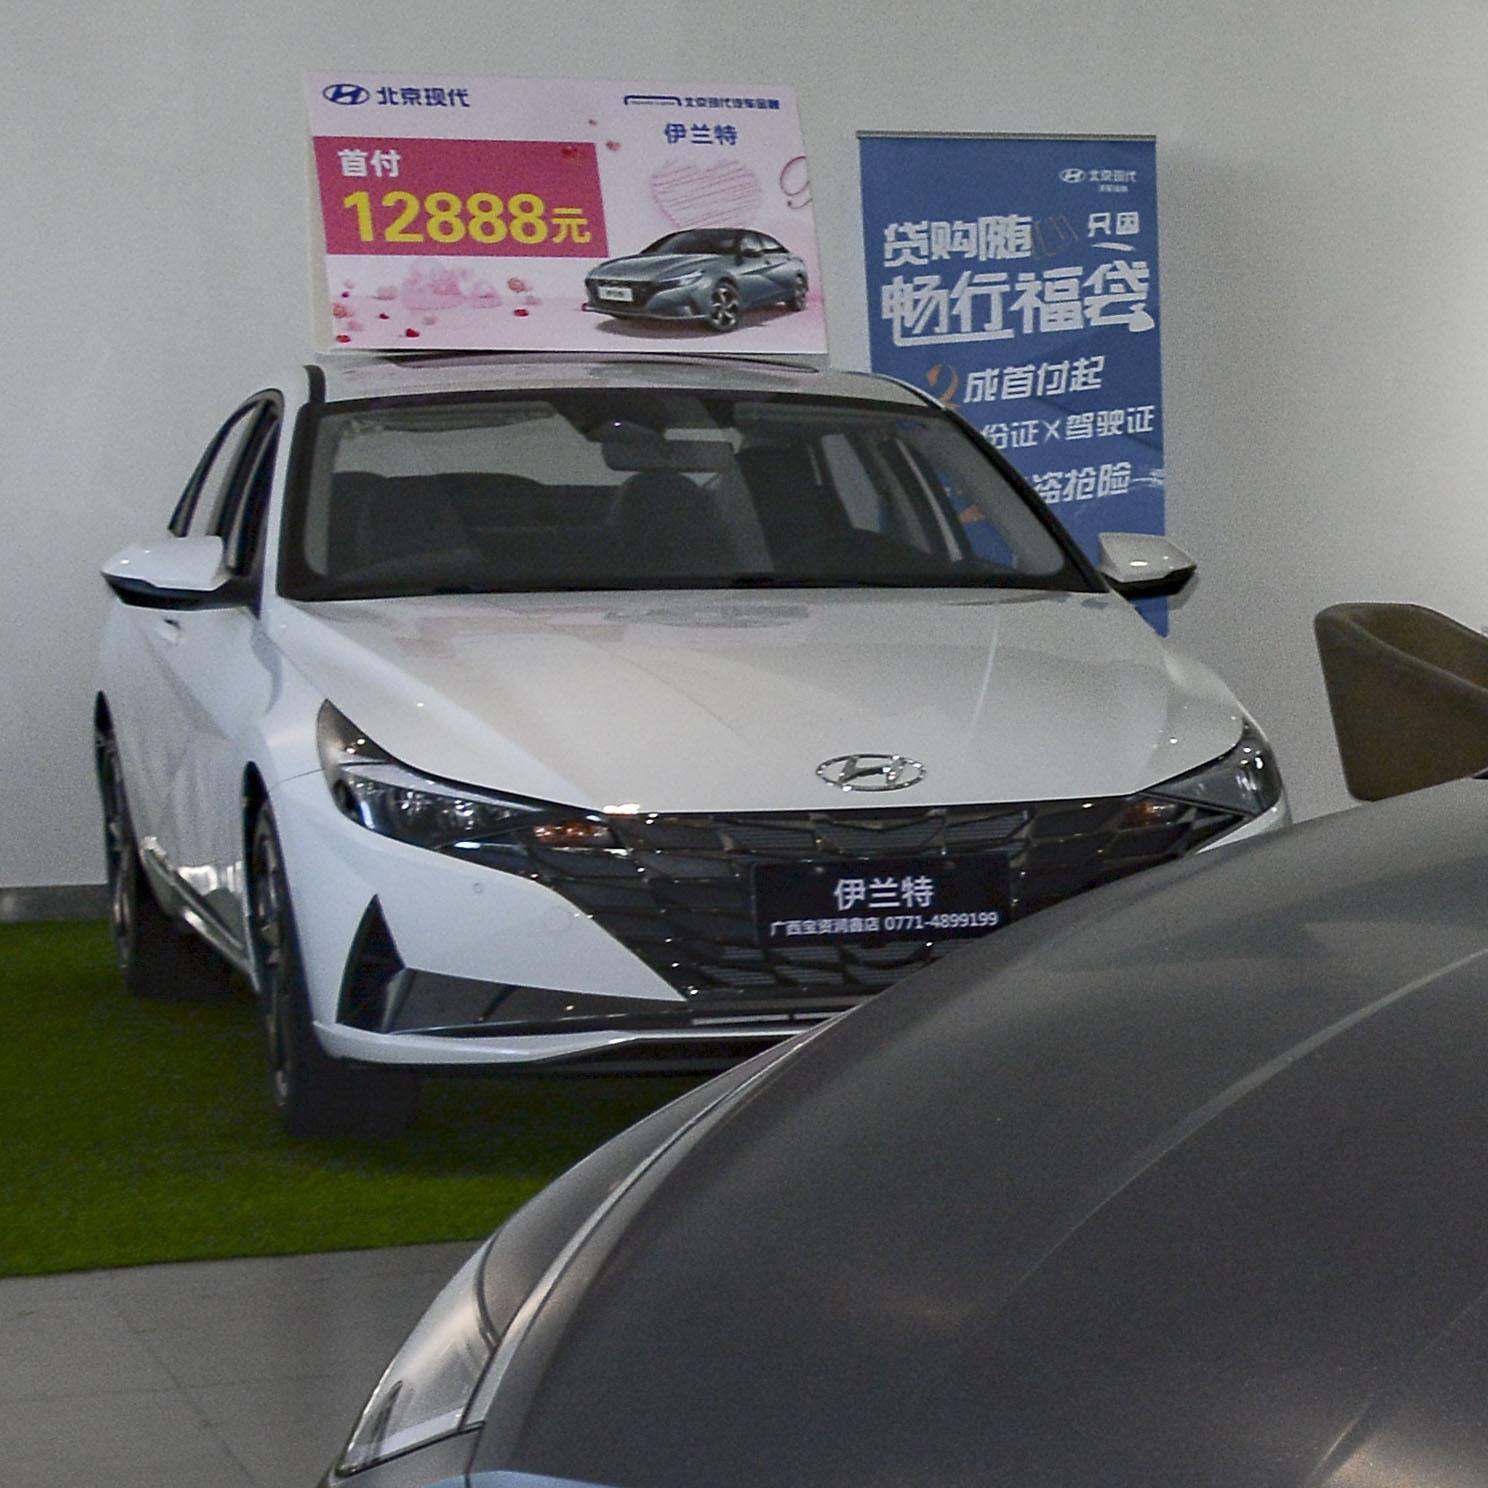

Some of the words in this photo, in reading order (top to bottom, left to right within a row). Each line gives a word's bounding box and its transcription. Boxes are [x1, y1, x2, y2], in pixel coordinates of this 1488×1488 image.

[377, 86, 469, 108] 北京现代
[664, 123, 738, 146] 伊兰特
[338, 149, 401, 178] 首付
[343, 191, 592, 245] 12888元
[881, 260, 1155, 346] 畅行福袋
[833, 875, 935, 911] 伊兰特
[884, 911, 999, 932] 0771-4899199
